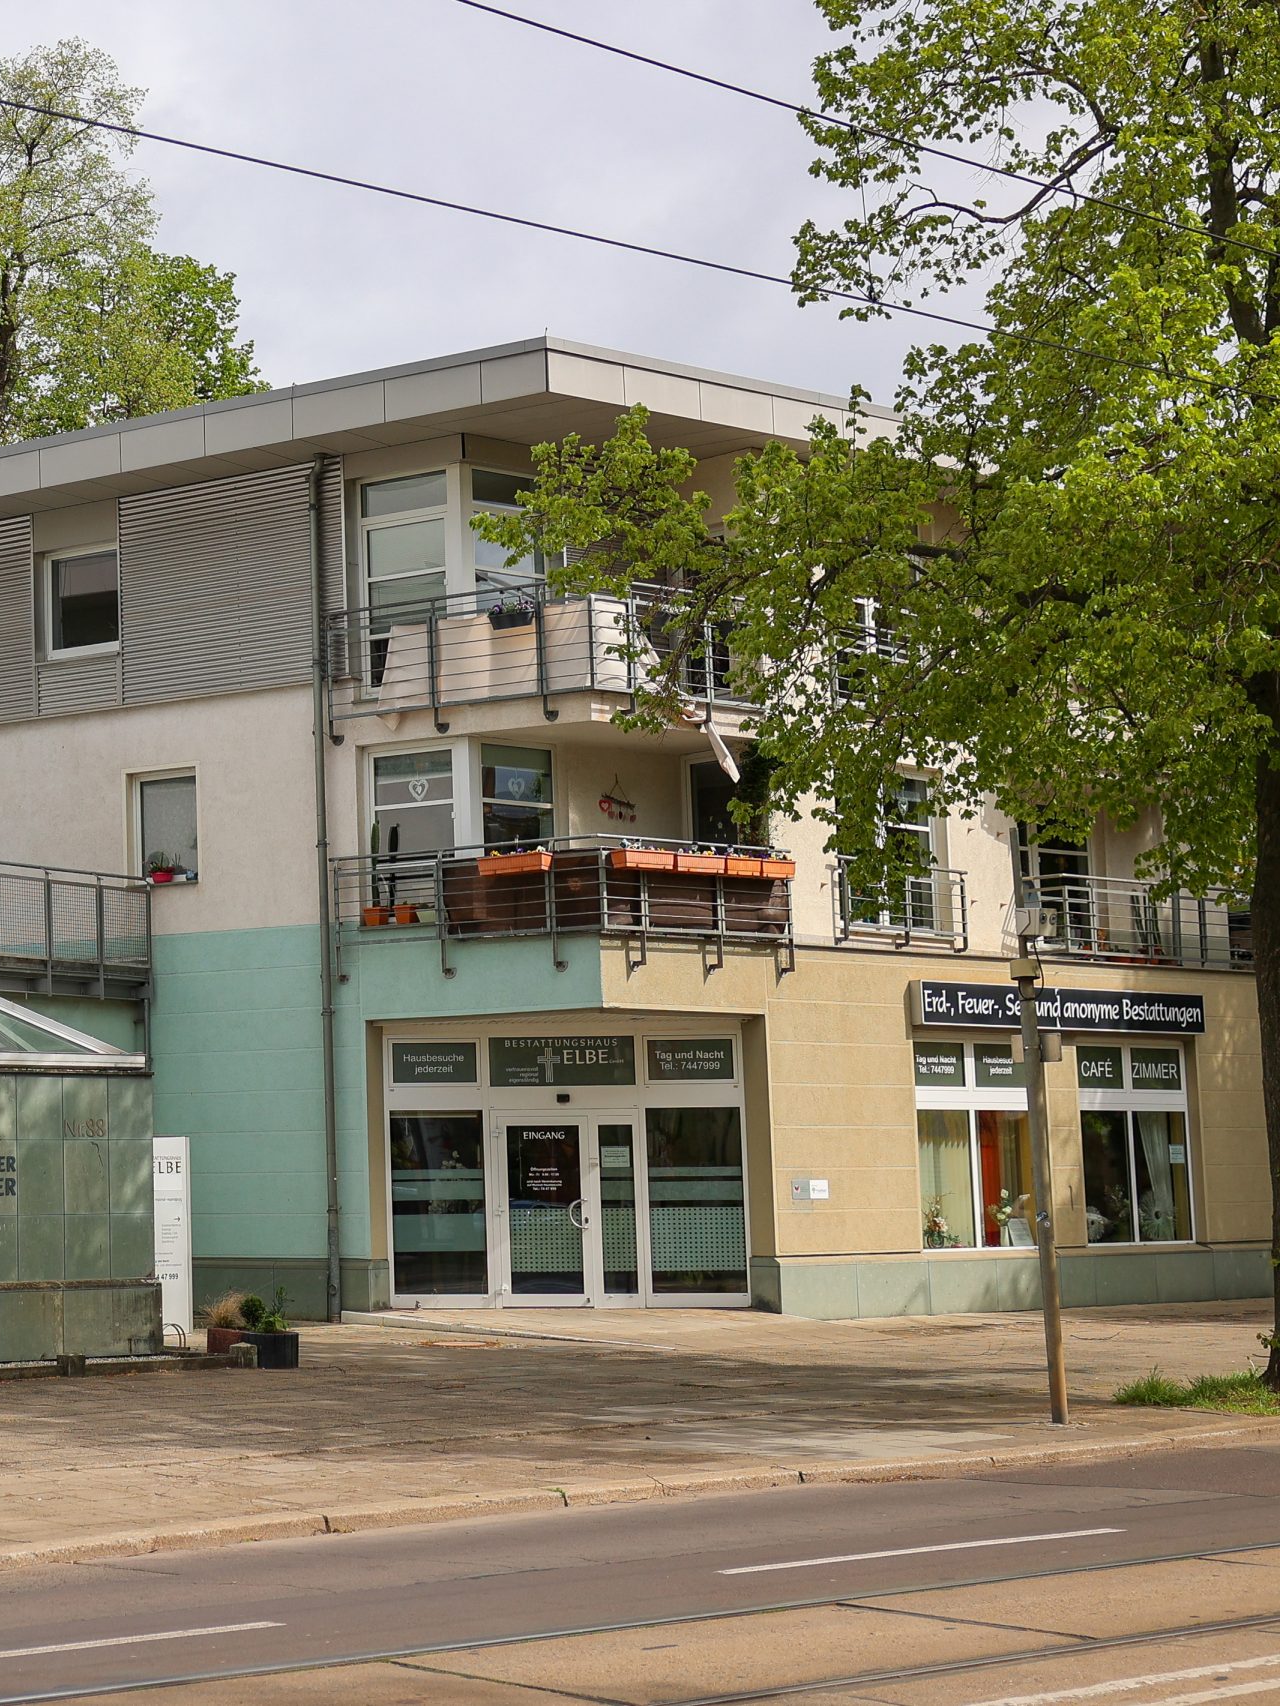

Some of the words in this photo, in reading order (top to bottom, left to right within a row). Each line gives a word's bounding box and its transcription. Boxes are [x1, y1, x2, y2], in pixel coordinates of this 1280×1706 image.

[1035, 993, 1061, 1018] und
[1063, 1000, 1120, 1023] anonyme
[1122, 999, 1202, 1027] Bestattungen
[504, 1038, 618, 1047] BESTATTUNGSHAUS
[403, 1053, 465, 1062] Hausbesuche
[562, 1049, 609, 1065] ELBE
[655, 1051, 673, 1061] Tag
[675, 1050, 693, 1059] und
[696, 1050, 724, 1059] Nacht
[915, 1054, 927, 1064] Tag
[940, 1055, 957, 1064] Nacht
[983, 1056, 1014, 1065] Hausbesuc
[414, 1064, 454, 1075] jederzeit
[660, 1061, 678, 1071] Tel.:
[681, 1061, 720, 1070] 7447999
[930, 1065, 955, 1074] 7447999
[989, 1066, 1013, 1076] jederzeit
[1081, 1058, 1114, 1078] CAFÉ
[1131, 1062, 1178, 1079] ZIMMER
[523, 1131, 566, 1140] EINGANG
